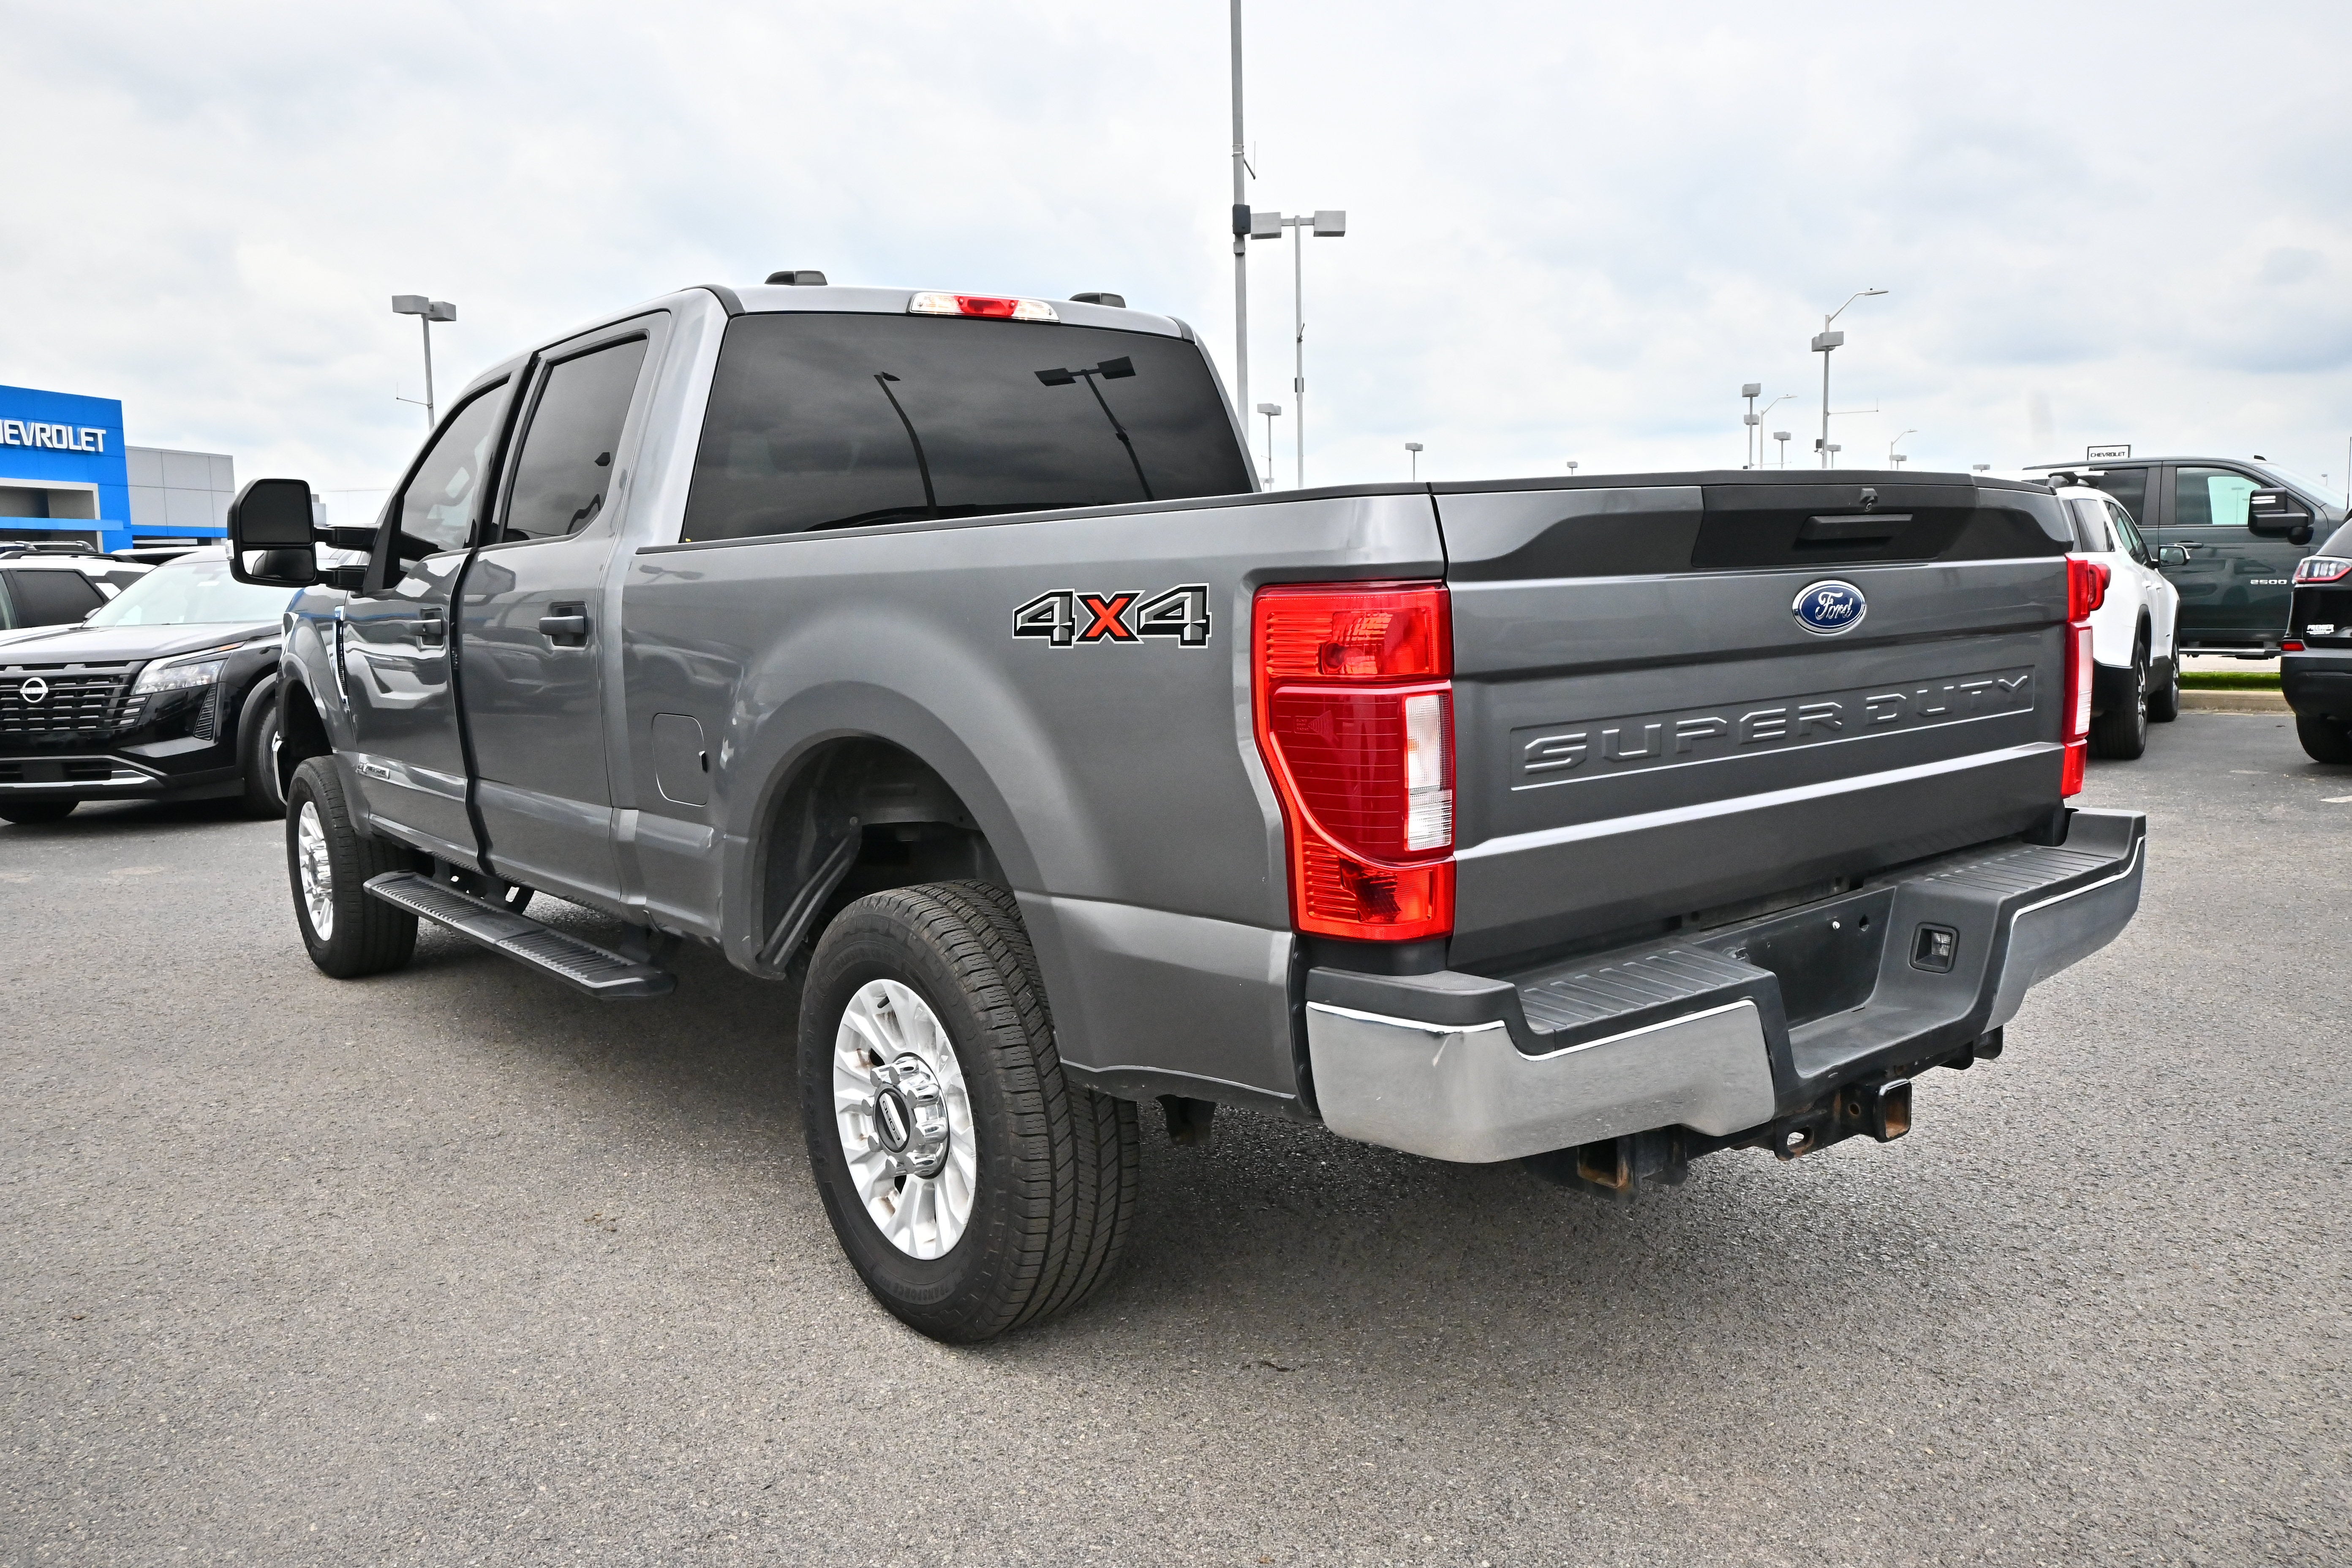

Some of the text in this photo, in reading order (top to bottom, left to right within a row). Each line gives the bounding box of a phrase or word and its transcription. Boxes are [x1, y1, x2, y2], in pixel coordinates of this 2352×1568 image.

[0, 419, 106, 452] EVROLET
[1815, 591, 1853, 620] Ford
[1525, 675, 2028, 774] SUPER DUTY
[882, 1100, 901, 1141] FORD
